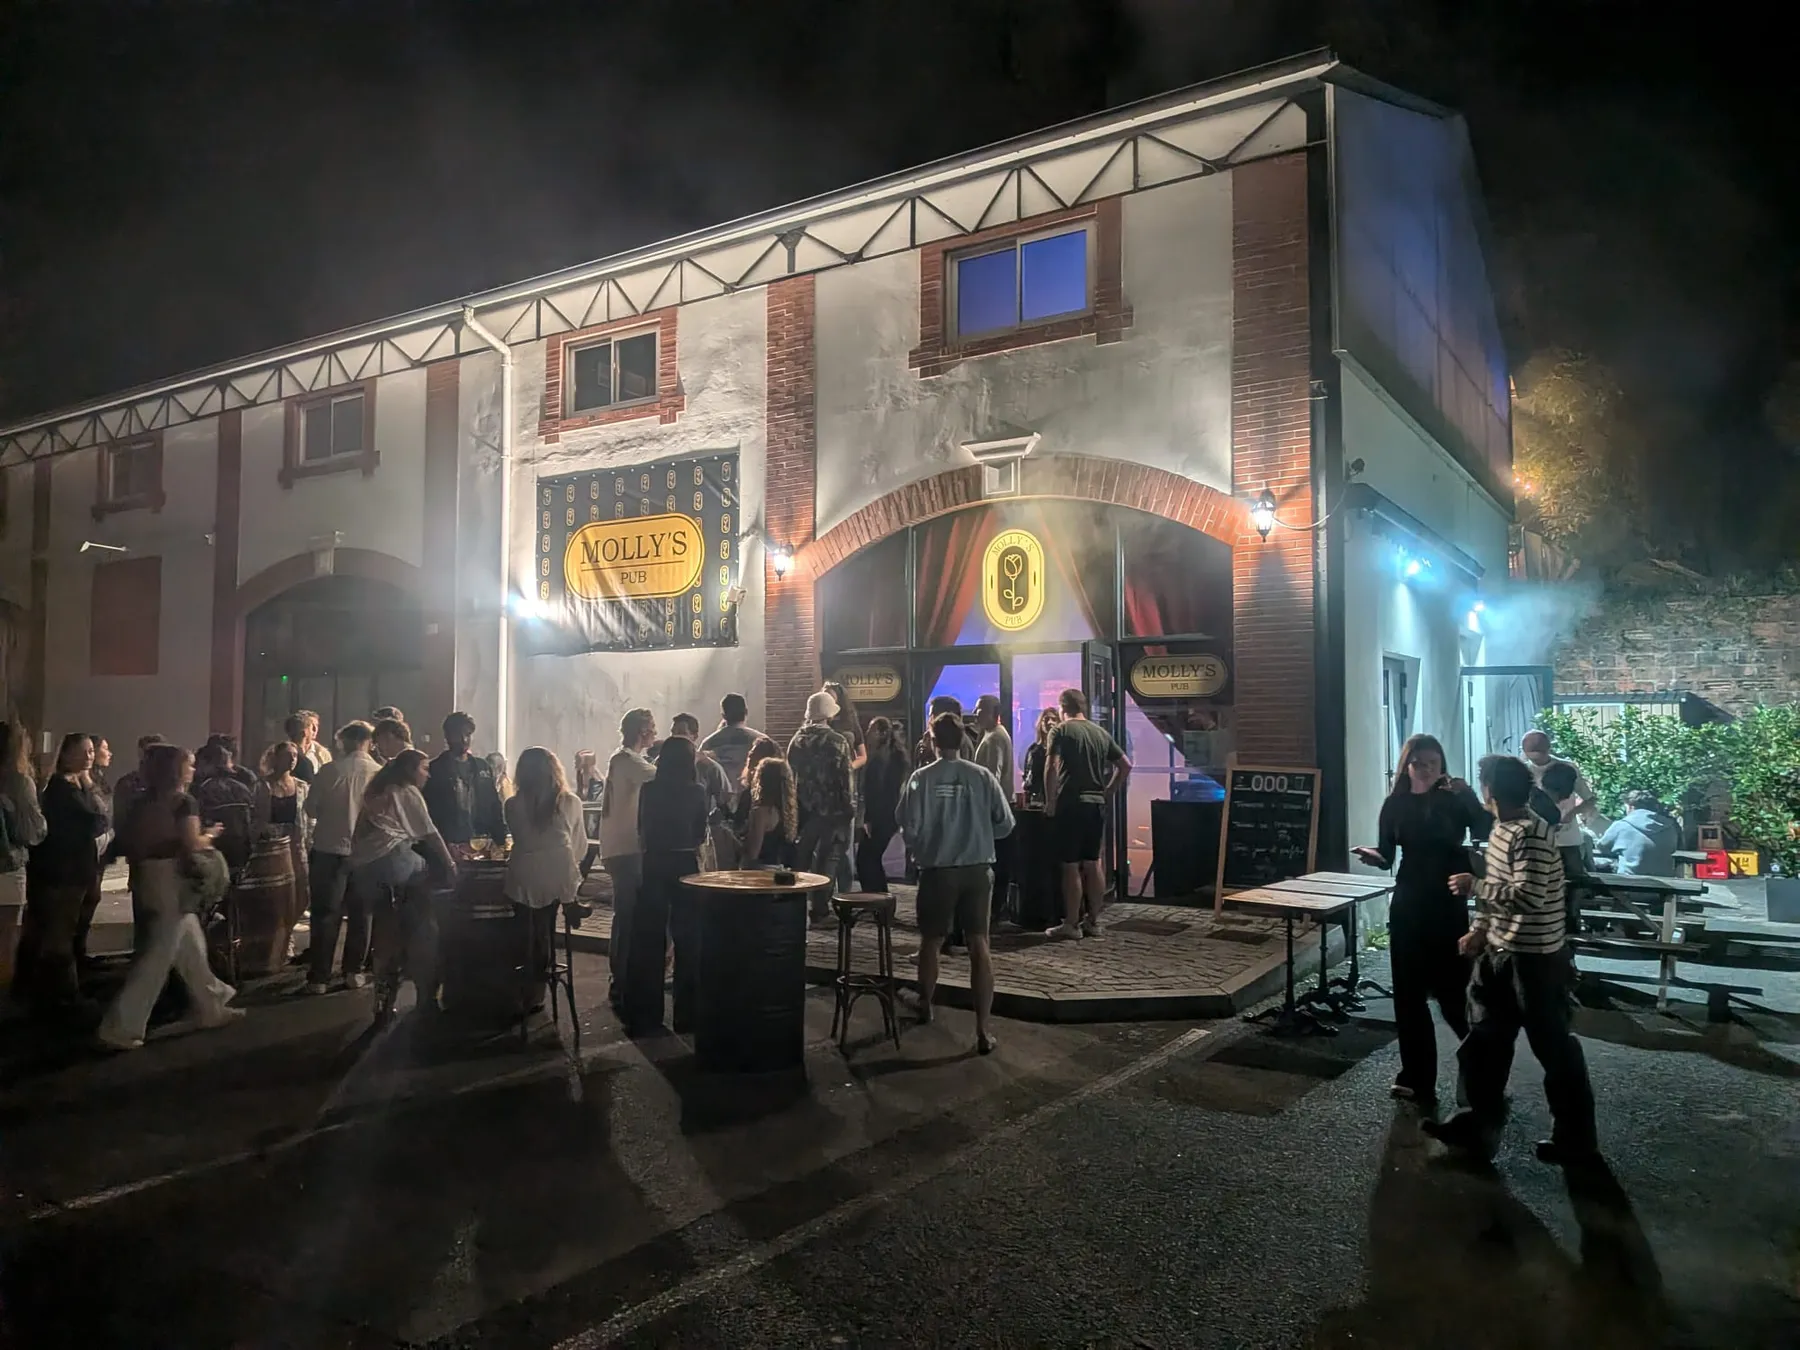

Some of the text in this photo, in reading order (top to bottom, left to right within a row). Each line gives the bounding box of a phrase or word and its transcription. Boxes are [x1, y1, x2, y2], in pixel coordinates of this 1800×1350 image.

[581, 531, 687, 564] MOLLY'S
[991, 535, 1035, 556] MOLLY'S
[620, 571, 647, 584] PUB
[1005, 615, 1023, 625] PUB
[1142, 663, 1217, 679] MOLLY'S
[1170, 682, 1189, 691] PUB
